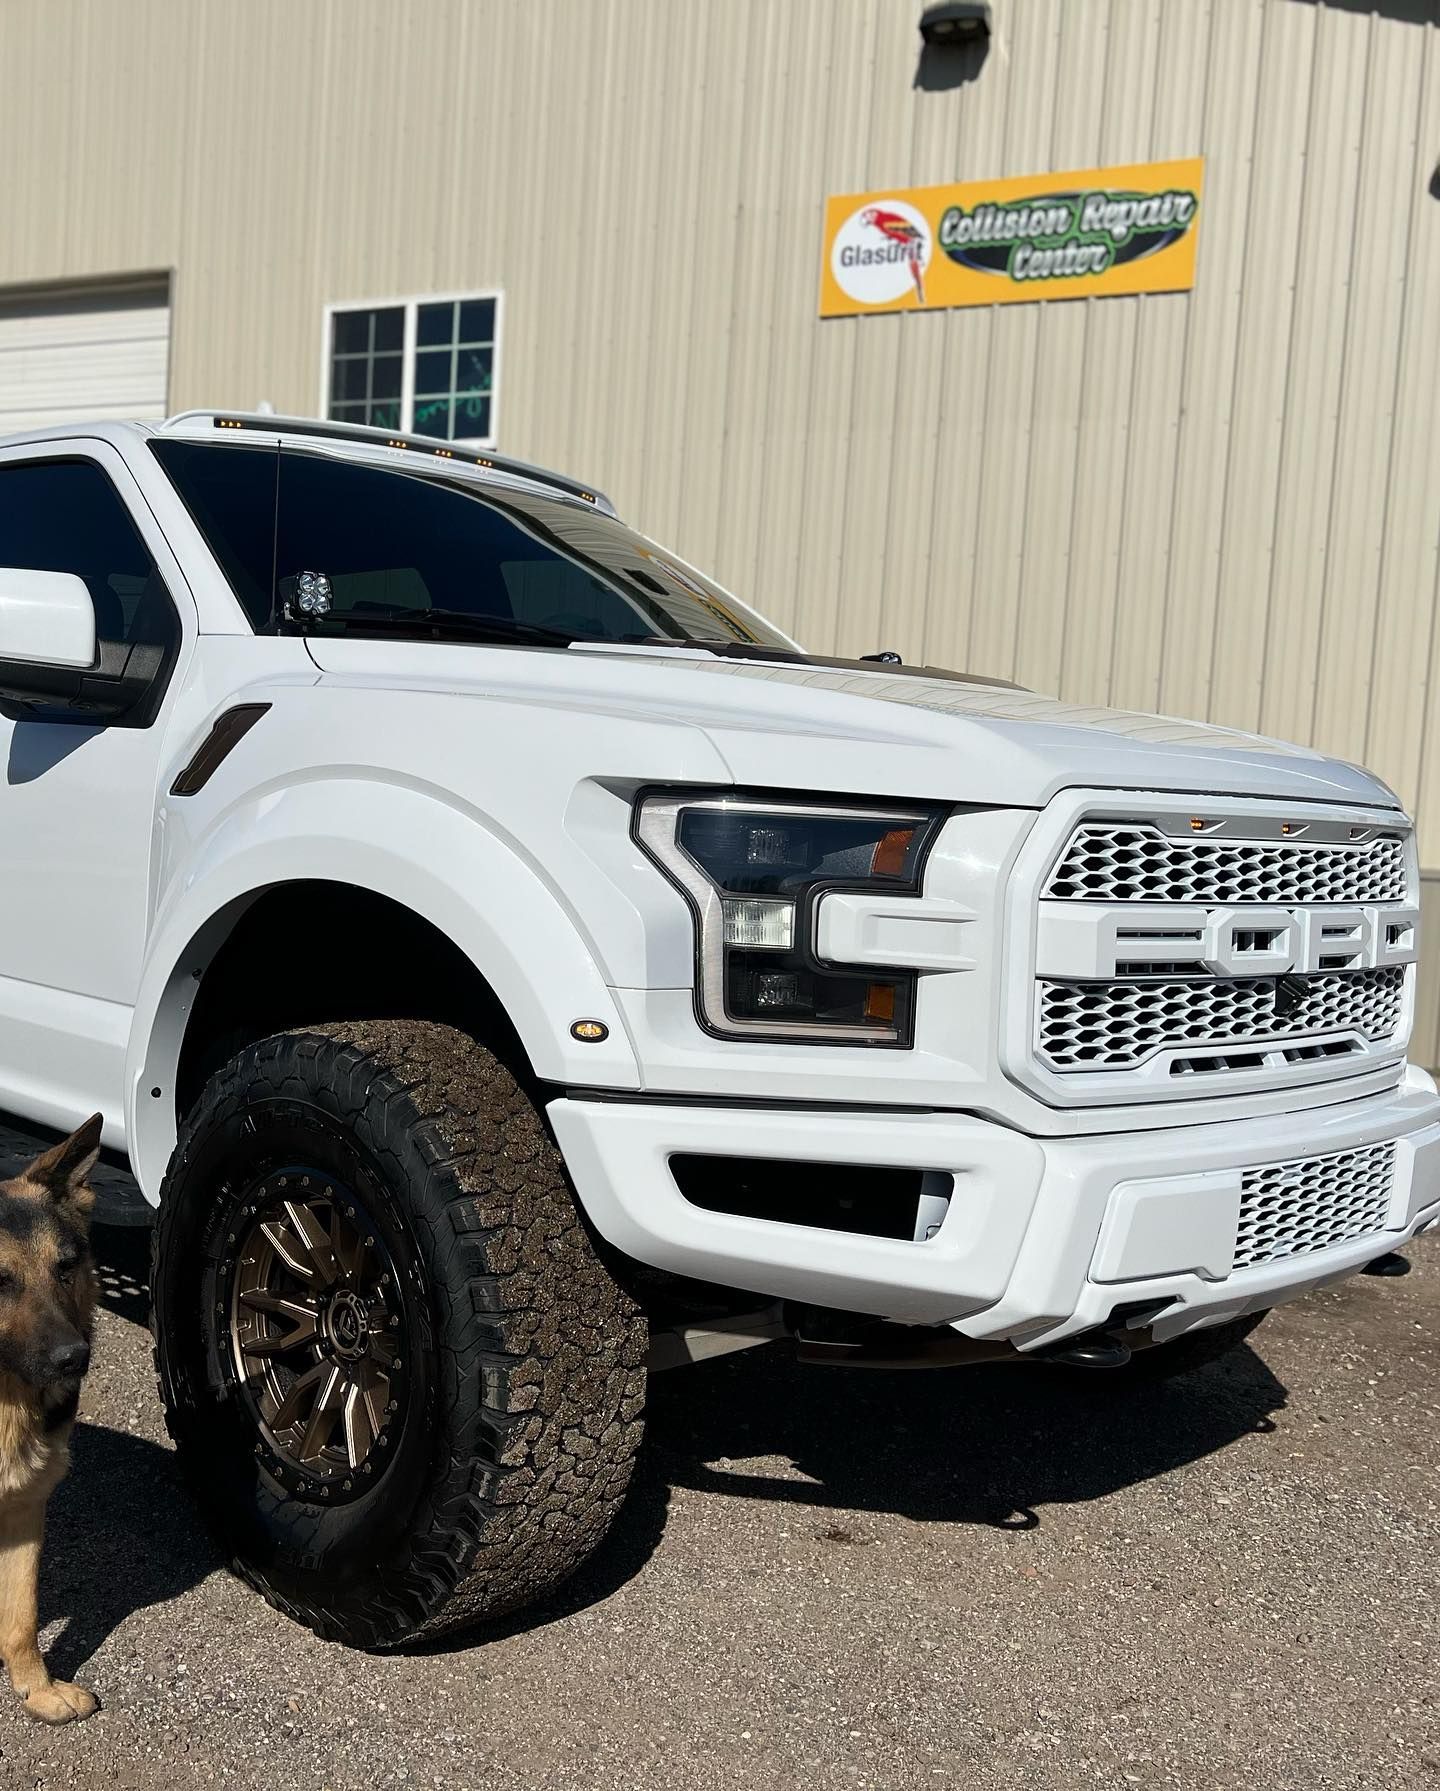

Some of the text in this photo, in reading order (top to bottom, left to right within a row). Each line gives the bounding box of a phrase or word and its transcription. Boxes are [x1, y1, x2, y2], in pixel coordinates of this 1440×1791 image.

[940, 192, 1194, 244] Collision Repair
[840, 242, 923, 268] Glasurit
[1012, 243, 1108, 280] Center
[1098, 905, 1418, 977] FORD
